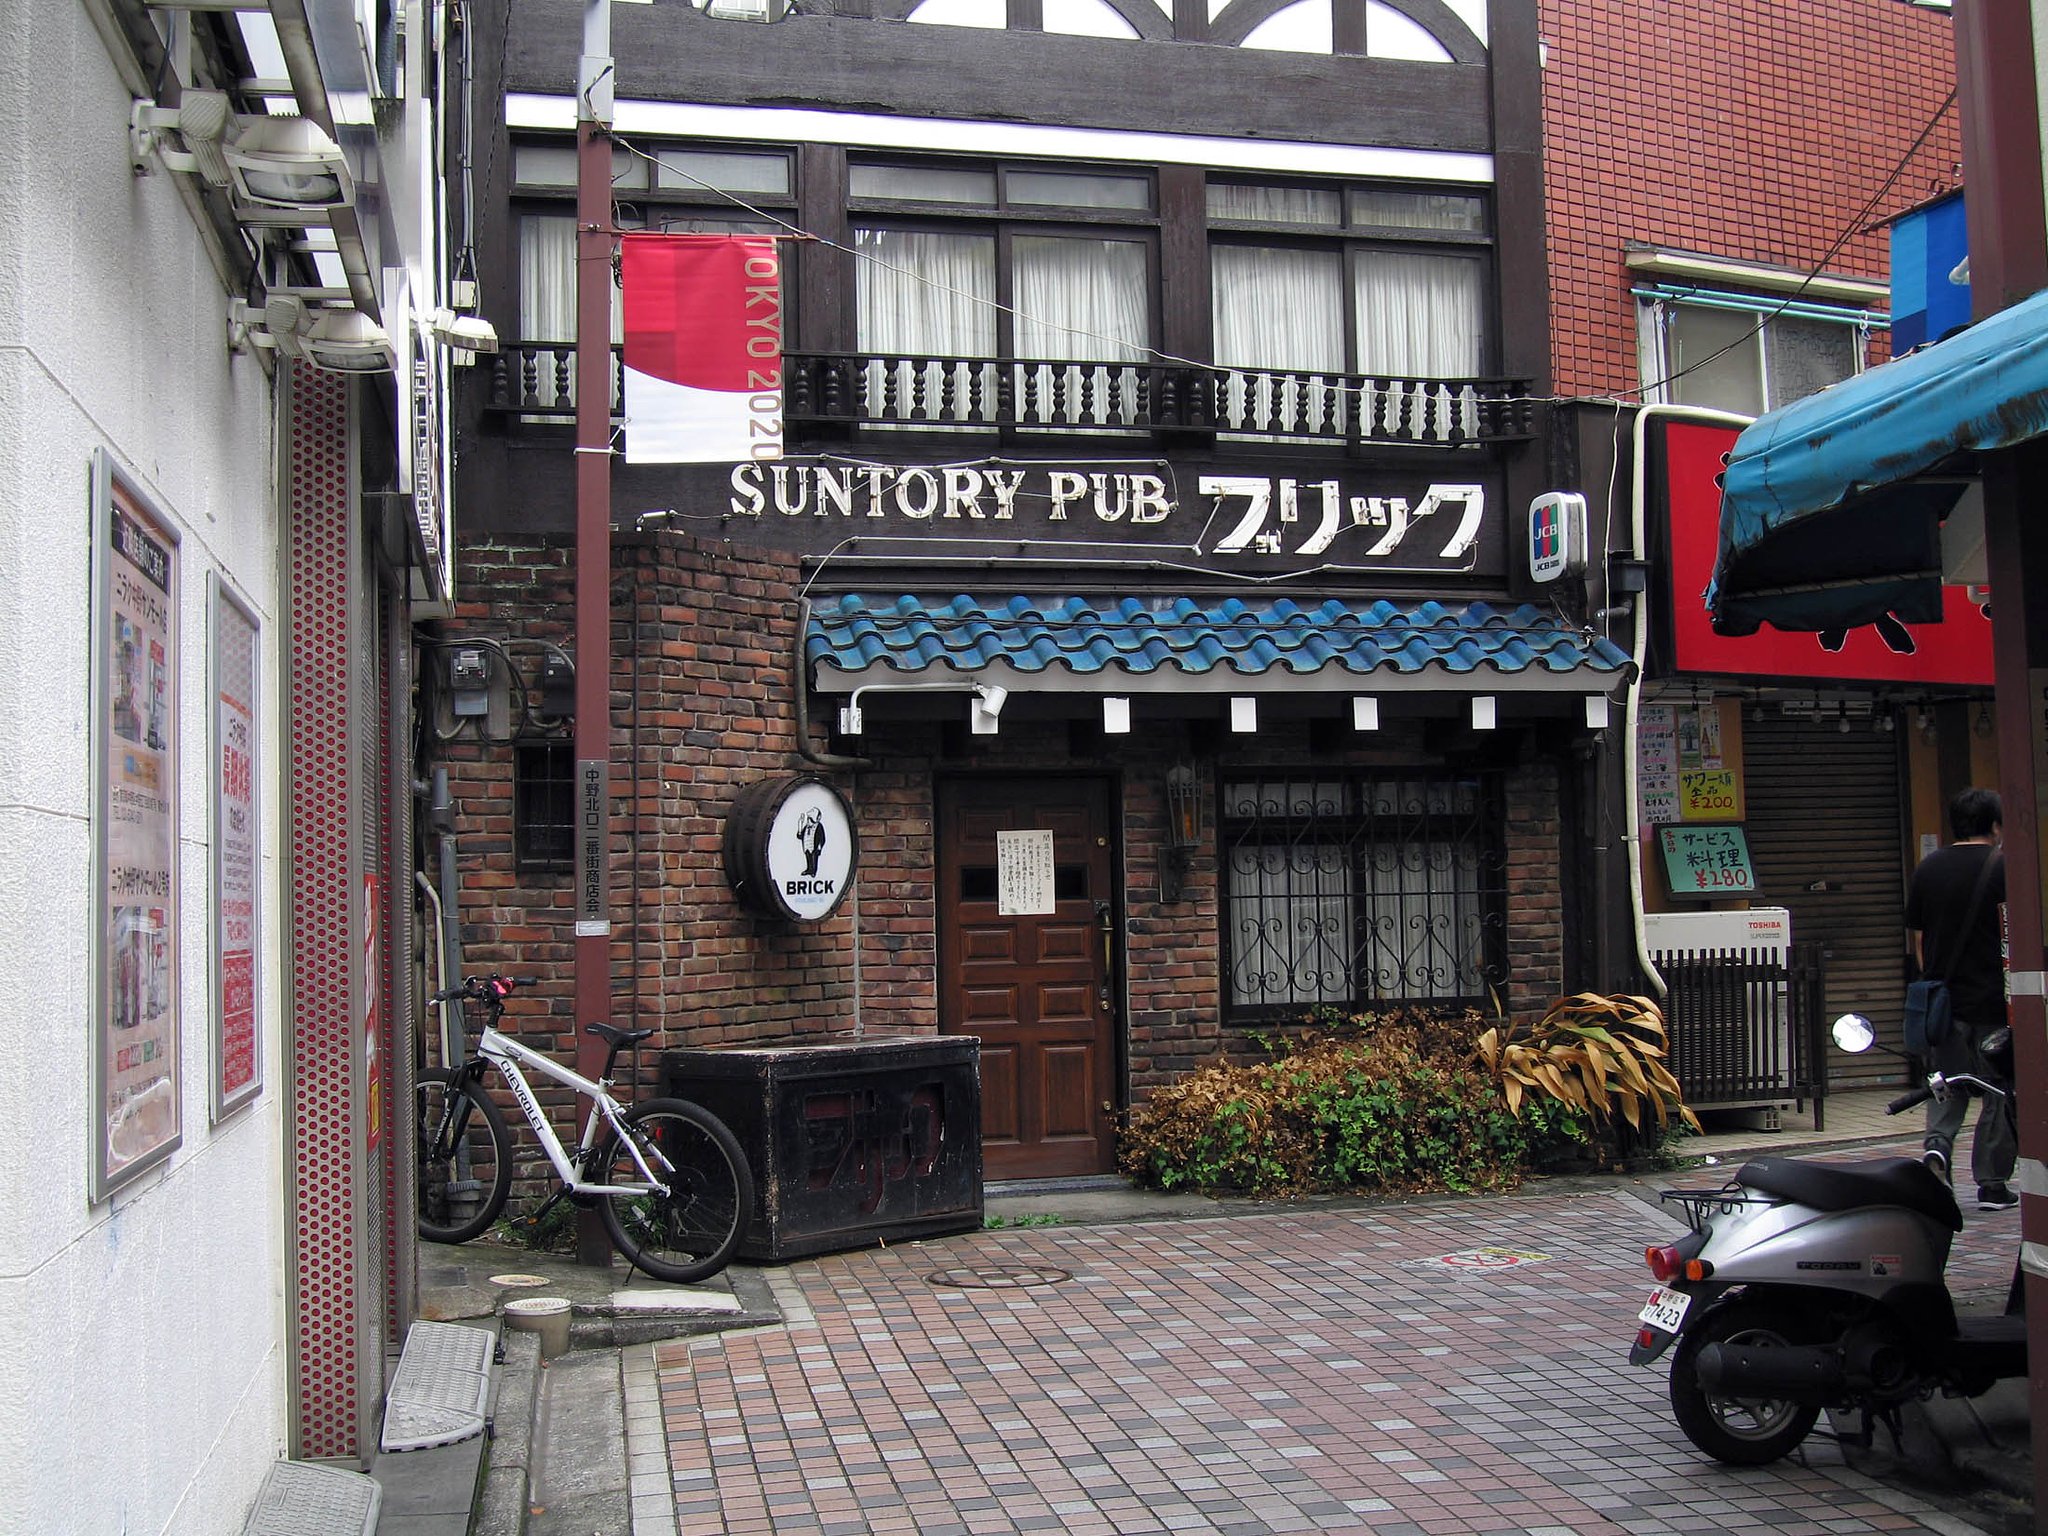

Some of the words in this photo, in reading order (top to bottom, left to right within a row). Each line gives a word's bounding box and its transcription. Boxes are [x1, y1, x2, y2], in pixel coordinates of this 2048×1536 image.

[745, 237, 781, 358] TOKYO
[748, 370, 784, 461] 2020
[730, 463, 1026, 520] SUNTORY
[1048, 470, 1172, 524] PUB
[1198, 475, 1484, 558] ブリック
[1534, 524, 1557, 540] JCB
[1535, 562, 1550, 572] JCB
[585, 769, 600, 912] 中野北口二番街商店会
[1682, 832, 1736, 846] サービス
[1686, 848, 1744, 869] 料理
[786, 880, 834, 895] BRICK
[1695, 868, 1748, 889] ¥280
[1748, 921, 1782, 929] TOSHIBA
[500, 1060, 545, 1132] CHEVROLET
